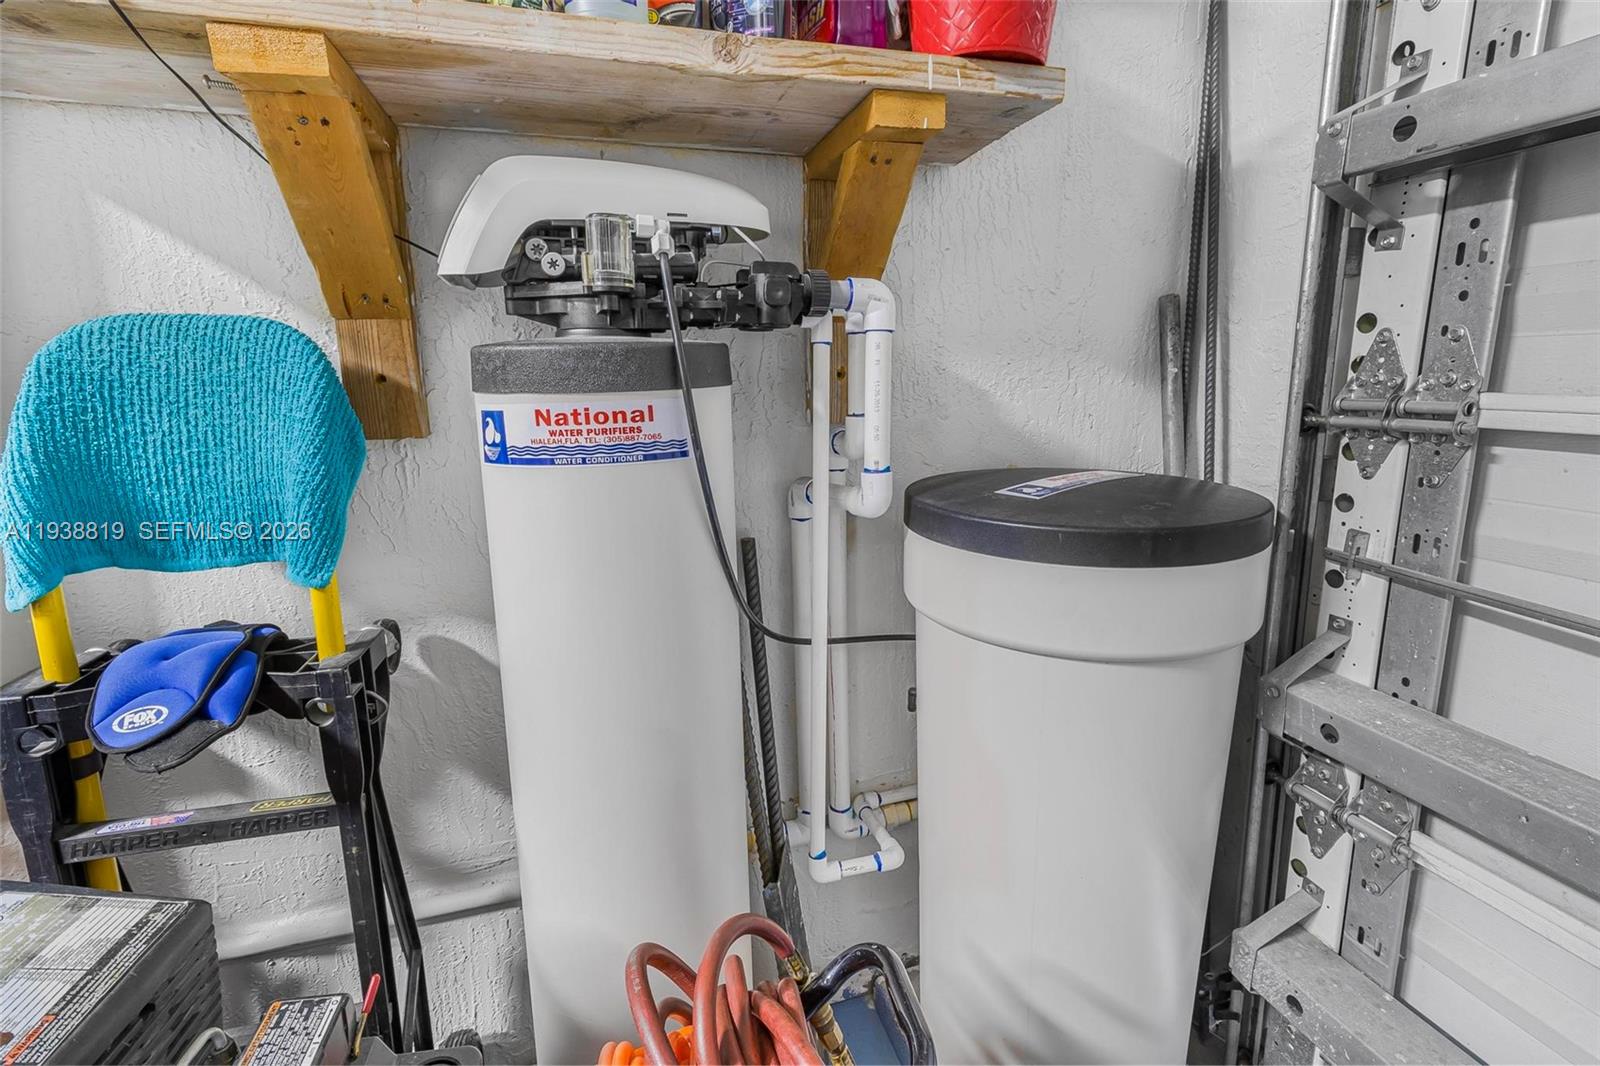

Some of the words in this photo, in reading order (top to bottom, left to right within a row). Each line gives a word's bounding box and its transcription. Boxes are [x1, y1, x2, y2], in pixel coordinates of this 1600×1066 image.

[534, 404, 655, 427] National
[548, 429, 583, 437] WATER
[587, 425, 643, 436] PURIFIERS
[585, 435, 601, 444] TEL:
[604, 433, 663, 443] (305)887-7065
[586, 454, 644, 464] CONDITIONER
[123, 708, 159, 730] FOX
[229, 809, 330, 838] HARPER
[70, 829, 180, 860] HARPER
